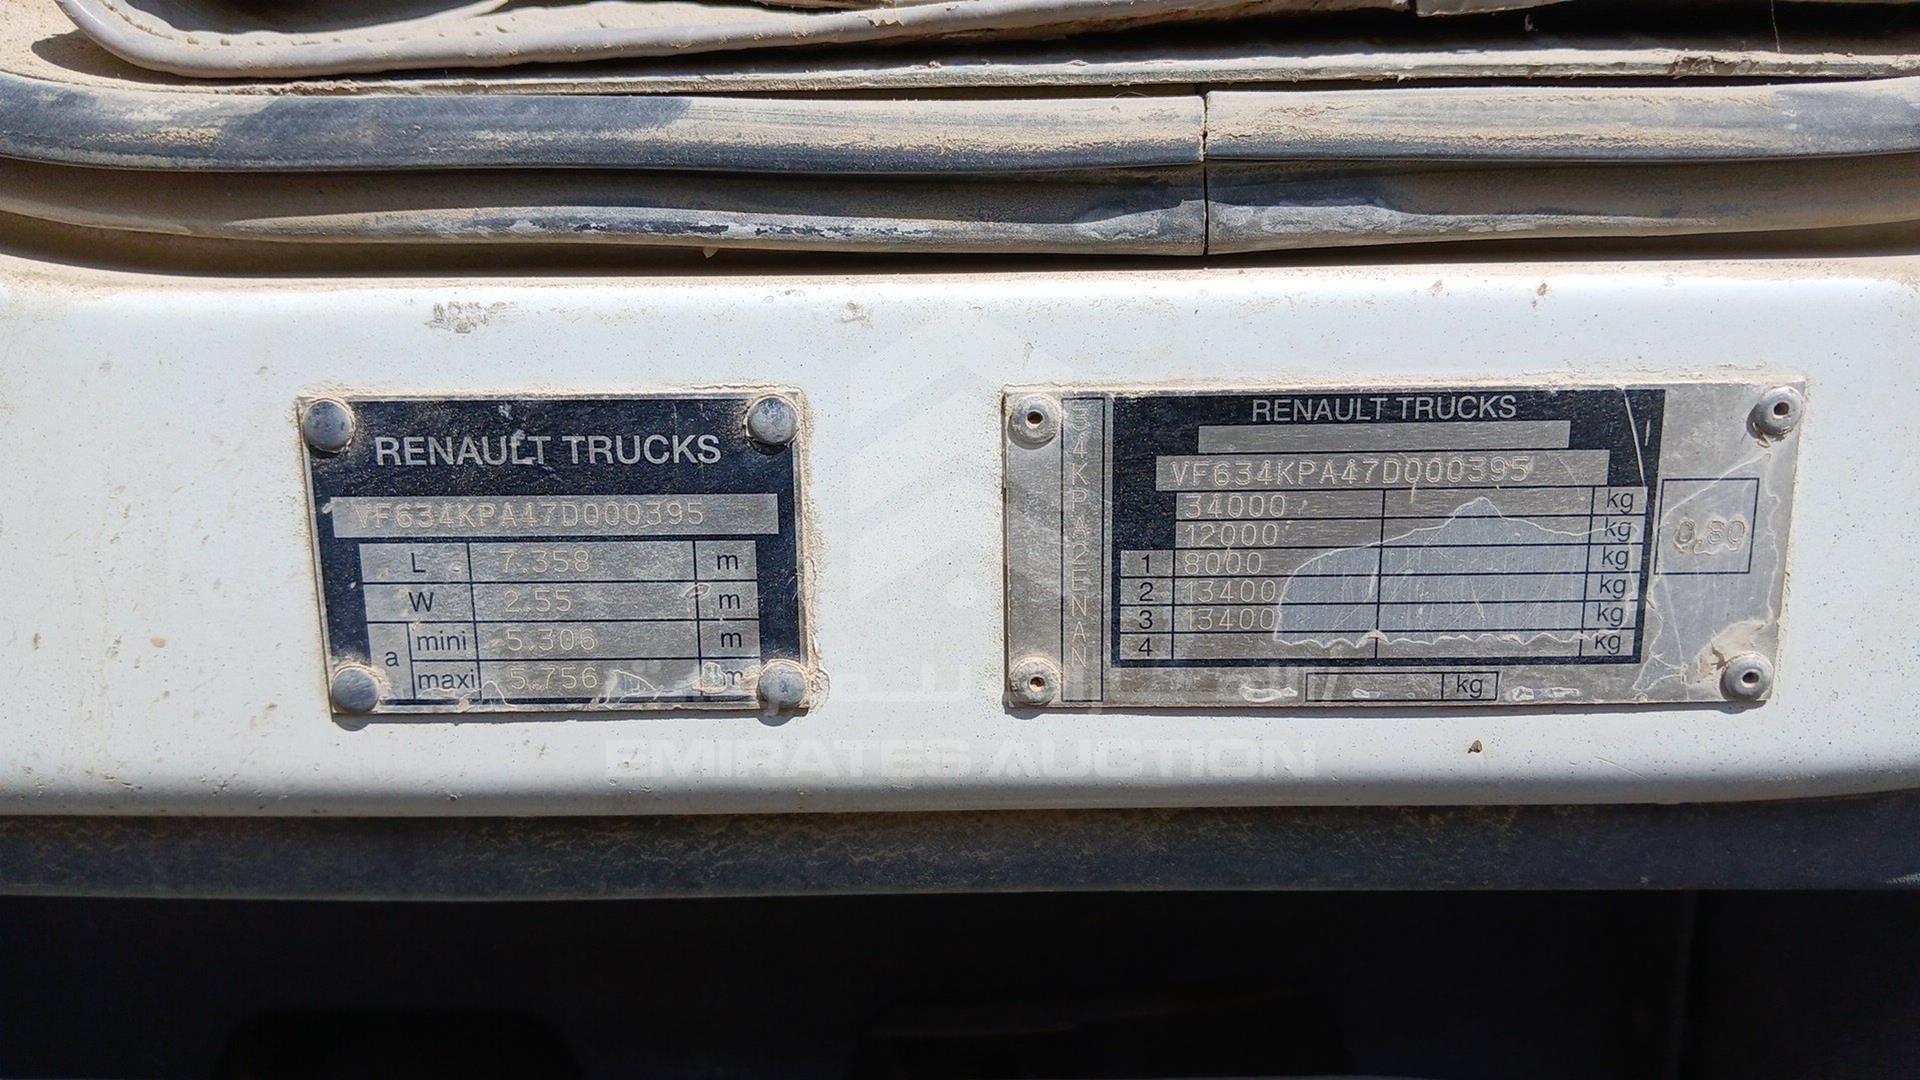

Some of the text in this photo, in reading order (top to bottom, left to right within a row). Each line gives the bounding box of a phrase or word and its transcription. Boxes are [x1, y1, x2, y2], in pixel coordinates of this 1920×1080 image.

[1252, 394, 1517, 422] RENAULT TRUCKS
[375, 434, 723, 467] RENAULT TRUCKS
[1170, 455, 1531, 487] VF634KPA47D000395
[353, 500, 705, 531] VF634KPA47D000395
[1184, 487, 1634, 519] 34000 kg
[1184, 517, 1632, 548] 12000 kg
[410, 550, 739, 573] L 7.358 m
[1141, 545, 1629, 575] 1 8000 kg
[408, 589, 741, 613] W 2.55 m
[1138, 574, 1626, 603] 2 13400 kg
[1138, 602, 1624, 631] 3 13400 kg
[416, 628, 743, 651] mini 5.306 m
[1137, 631, 1621, 657] 4 kg
[384, 651, 399, 667] a
[417, 668, 480, 690] maxi
[510, 666, 599, 690] 5.756
[1456, 674, 1484, 698] kg
